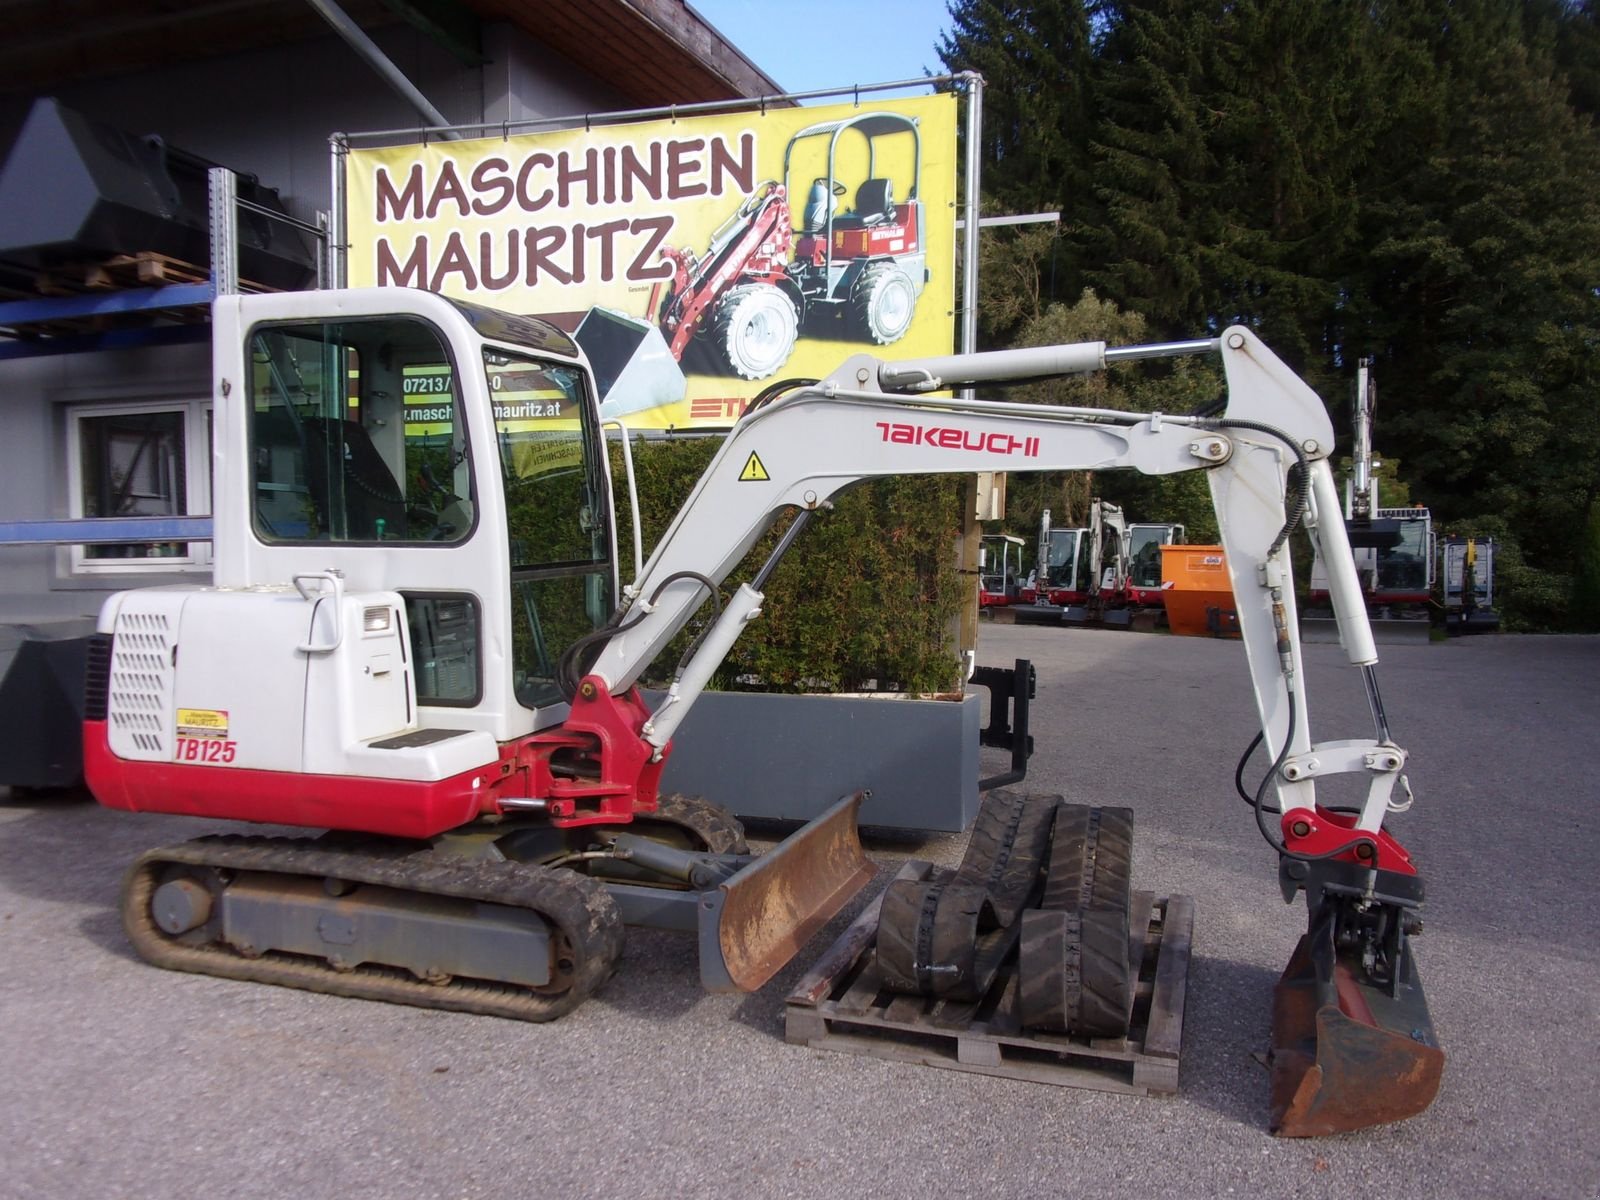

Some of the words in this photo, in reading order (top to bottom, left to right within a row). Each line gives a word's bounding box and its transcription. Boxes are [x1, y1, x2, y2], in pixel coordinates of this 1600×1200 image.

[376, 134, 753, 222] MASCHINEN
[376, 215, 675, 291] MAURITZ
[175, 738, 237, 763] TB125
